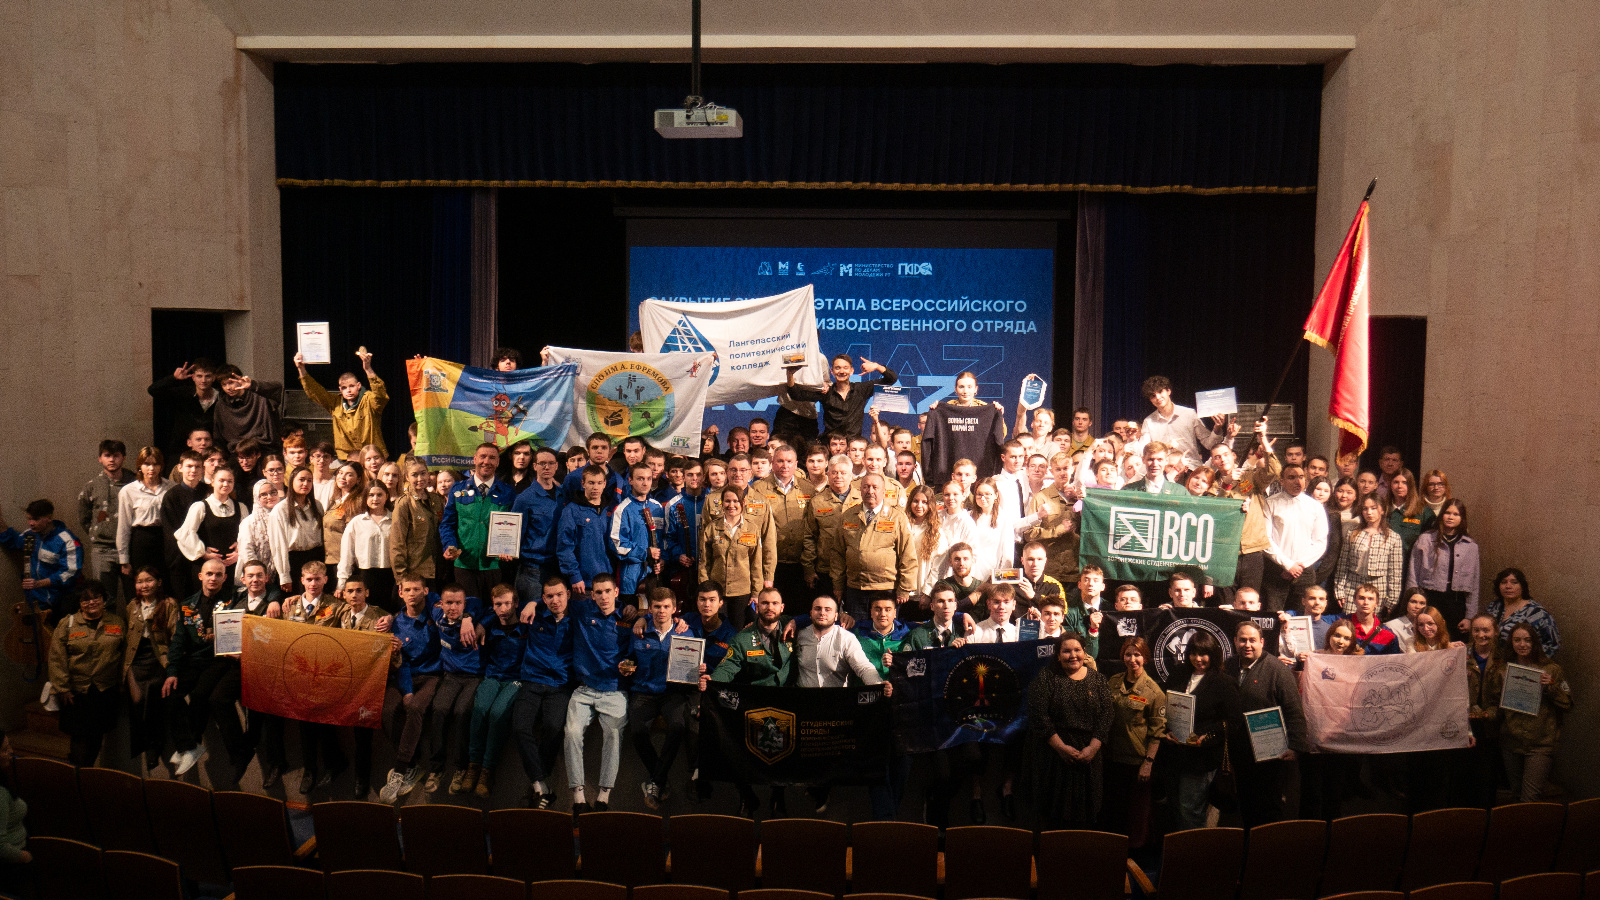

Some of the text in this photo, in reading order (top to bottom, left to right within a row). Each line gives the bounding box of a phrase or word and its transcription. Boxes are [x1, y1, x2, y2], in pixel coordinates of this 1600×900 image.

[814, 296, 1027, 313] ЭТАПА ВСЕРОССИЙСКОГО
[816, 318, 1038, 334] ИЗВОДСТВЕННОГО ОТРЯДА
[728, 331, 791, 348] Лангепасский
[729, 341, 807, 360] политехнический
[730, 360, 771, 371] колледж
[1160, 509, 1215, 563] ВСО
